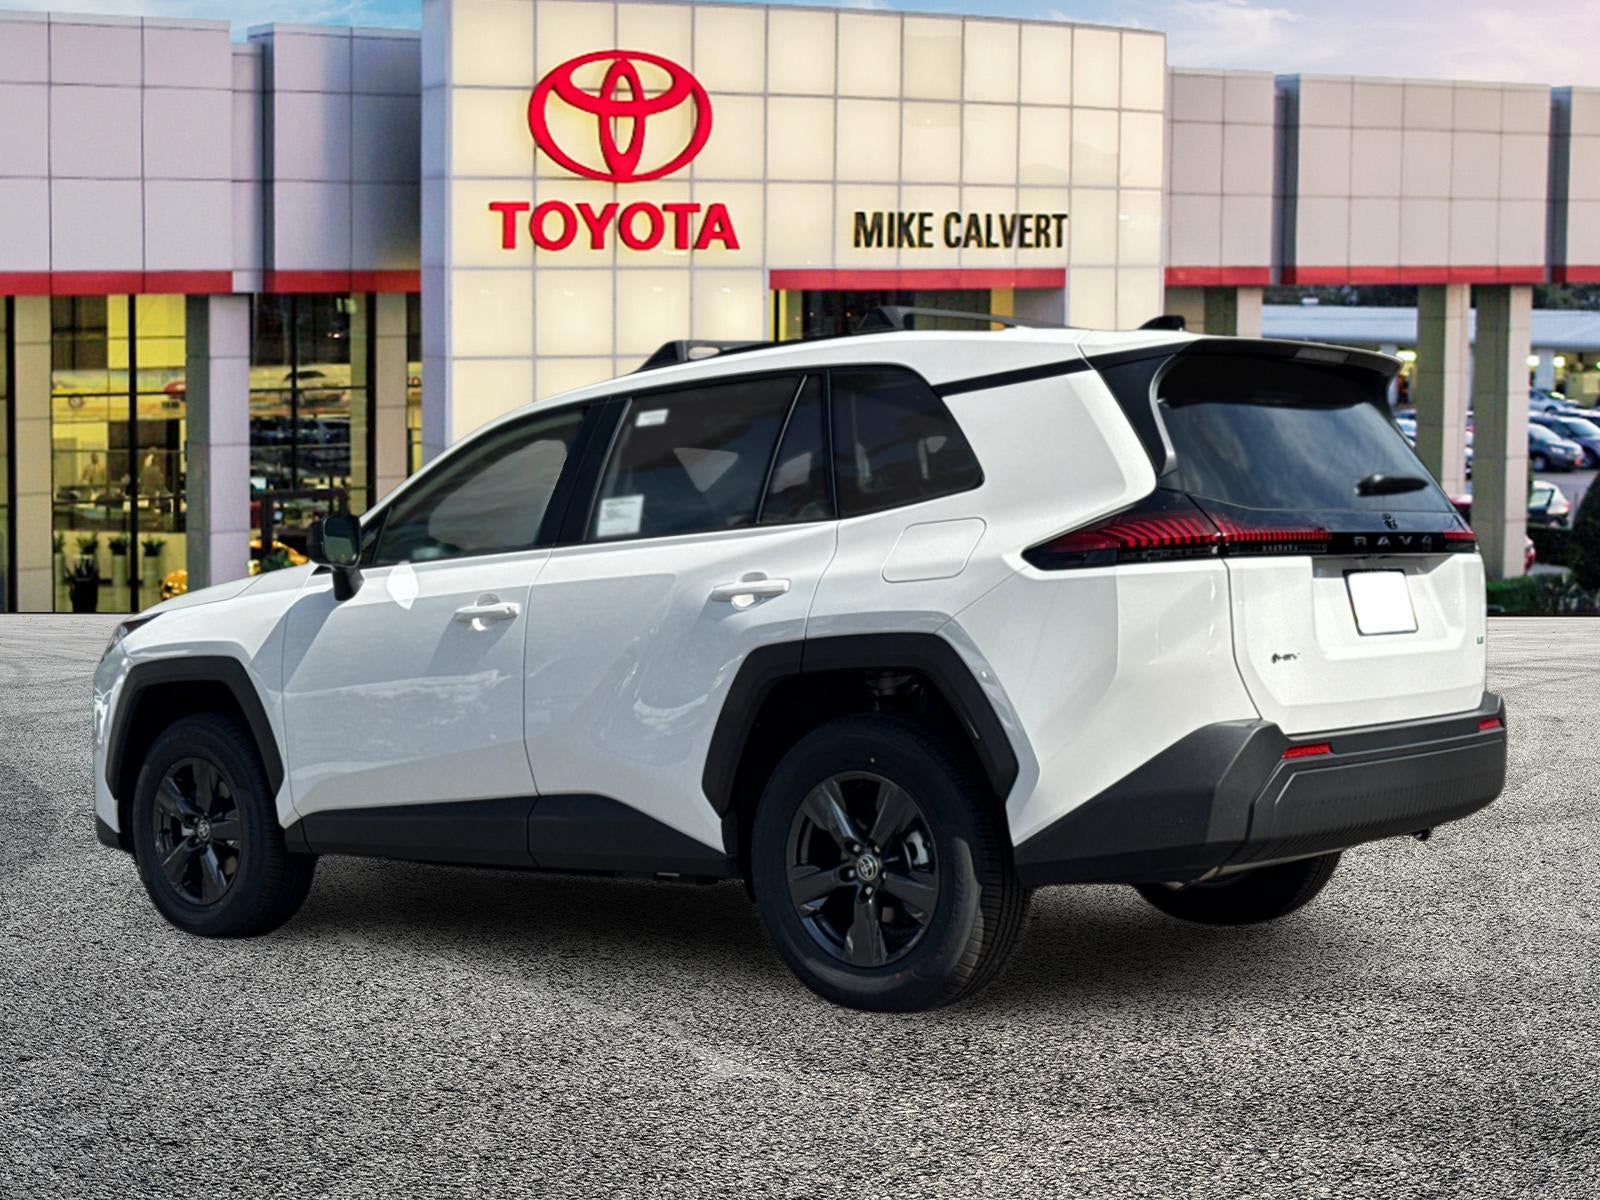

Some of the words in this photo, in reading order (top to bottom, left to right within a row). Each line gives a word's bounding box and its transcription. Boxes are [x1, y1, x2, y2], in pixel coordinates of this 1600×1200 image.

[489, 200, 740, 251] TOYOTA
[853, 211, 934, 249] MIKE
[943, 211, 1068, 249] CALVERT
